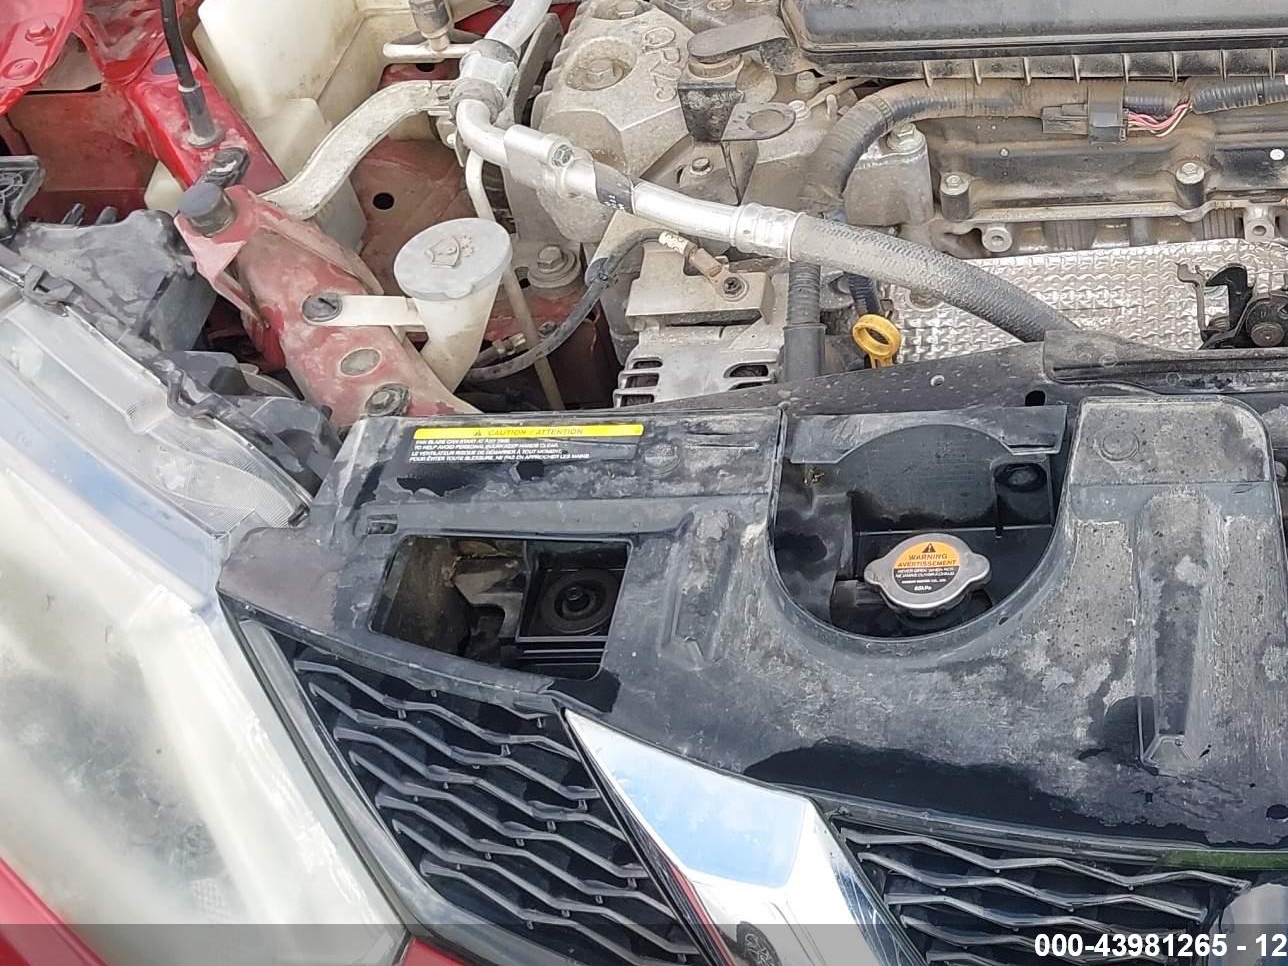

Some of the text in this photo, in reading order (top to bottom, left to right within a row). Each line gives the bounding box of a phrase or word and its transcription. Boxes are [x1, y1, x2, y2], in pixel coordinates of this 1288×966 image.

[535, 428, 584, 436] ATTENTION
[908, 553, 948, 561] WARNING
[898, 560, 956, 568] AVERTISSEMENT
